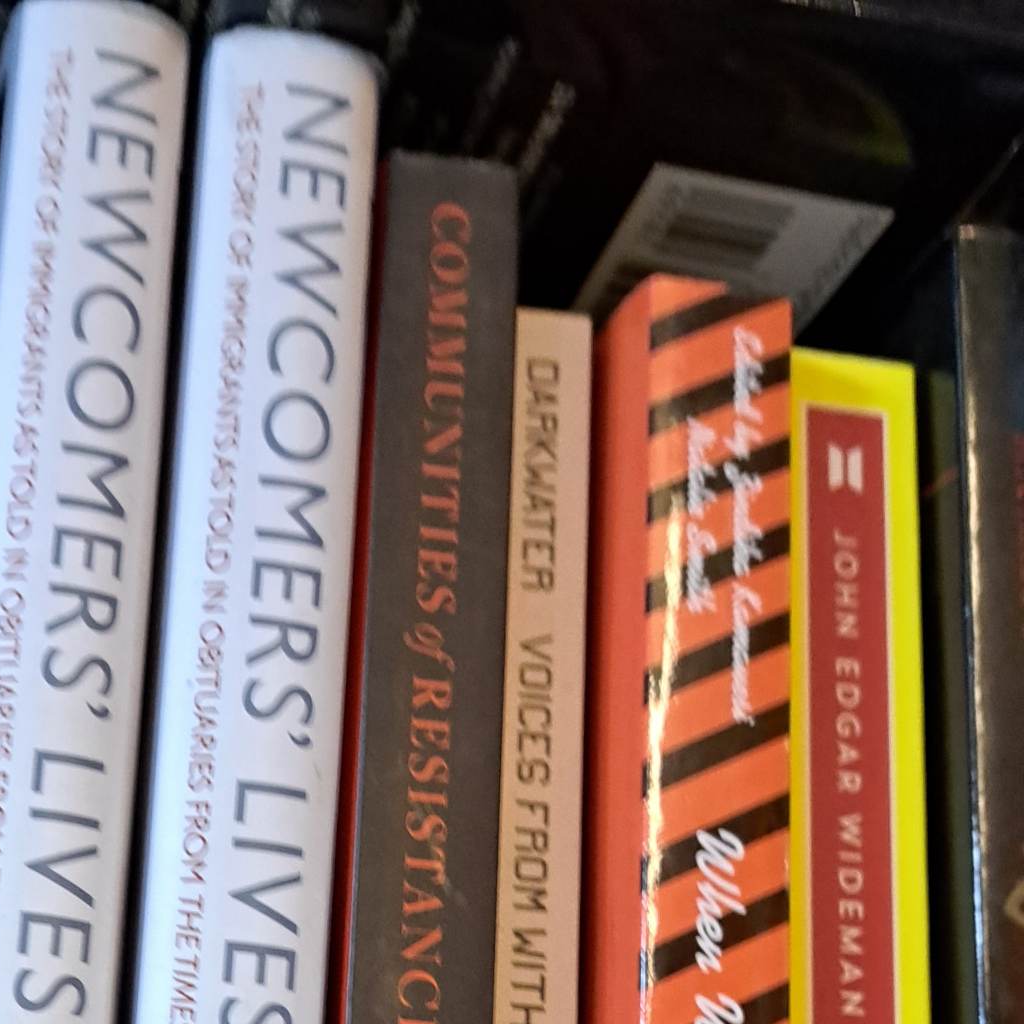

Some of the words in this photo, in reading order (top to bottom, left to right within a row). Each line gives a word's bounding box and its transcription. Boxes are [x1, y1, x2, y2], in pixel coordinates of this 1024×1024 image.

[39, 101, 71, 191] STORY
[231, 137, 262, 227] STORY
[32, 194, 62, 236] OF
[227, 229, 254, 272] OF
[16, 239, 56, 416] IMMIGRANTS
[213, 275, 251, 455] IMMIGRANTS
[414, 201, 473, 616] COMMUNITIES
[5, 460, 38, 541] TOLD
[519, 357, 560, 594] DARKWATER
[0, 545, 31, 583] IN
[205, 494, 236, 572] TOLD
[829, 528, 860, 638] JOHN
[202, 578, 230, 615] IN
[403, 619, 456, 673] of
[186, 618, 227, 795] OBITUARIES
[516, 633, 553, 788] VOICES
[832, 657, 864, 796] EDGAR
[13, 748, 108, 1017] LIVES
[179, 798, 214, 887] FROM
[514, 798, 550, 913] FROM
[695, 827, 745, 976] When
[836, 813, 867, 1018] WIDEMAN
